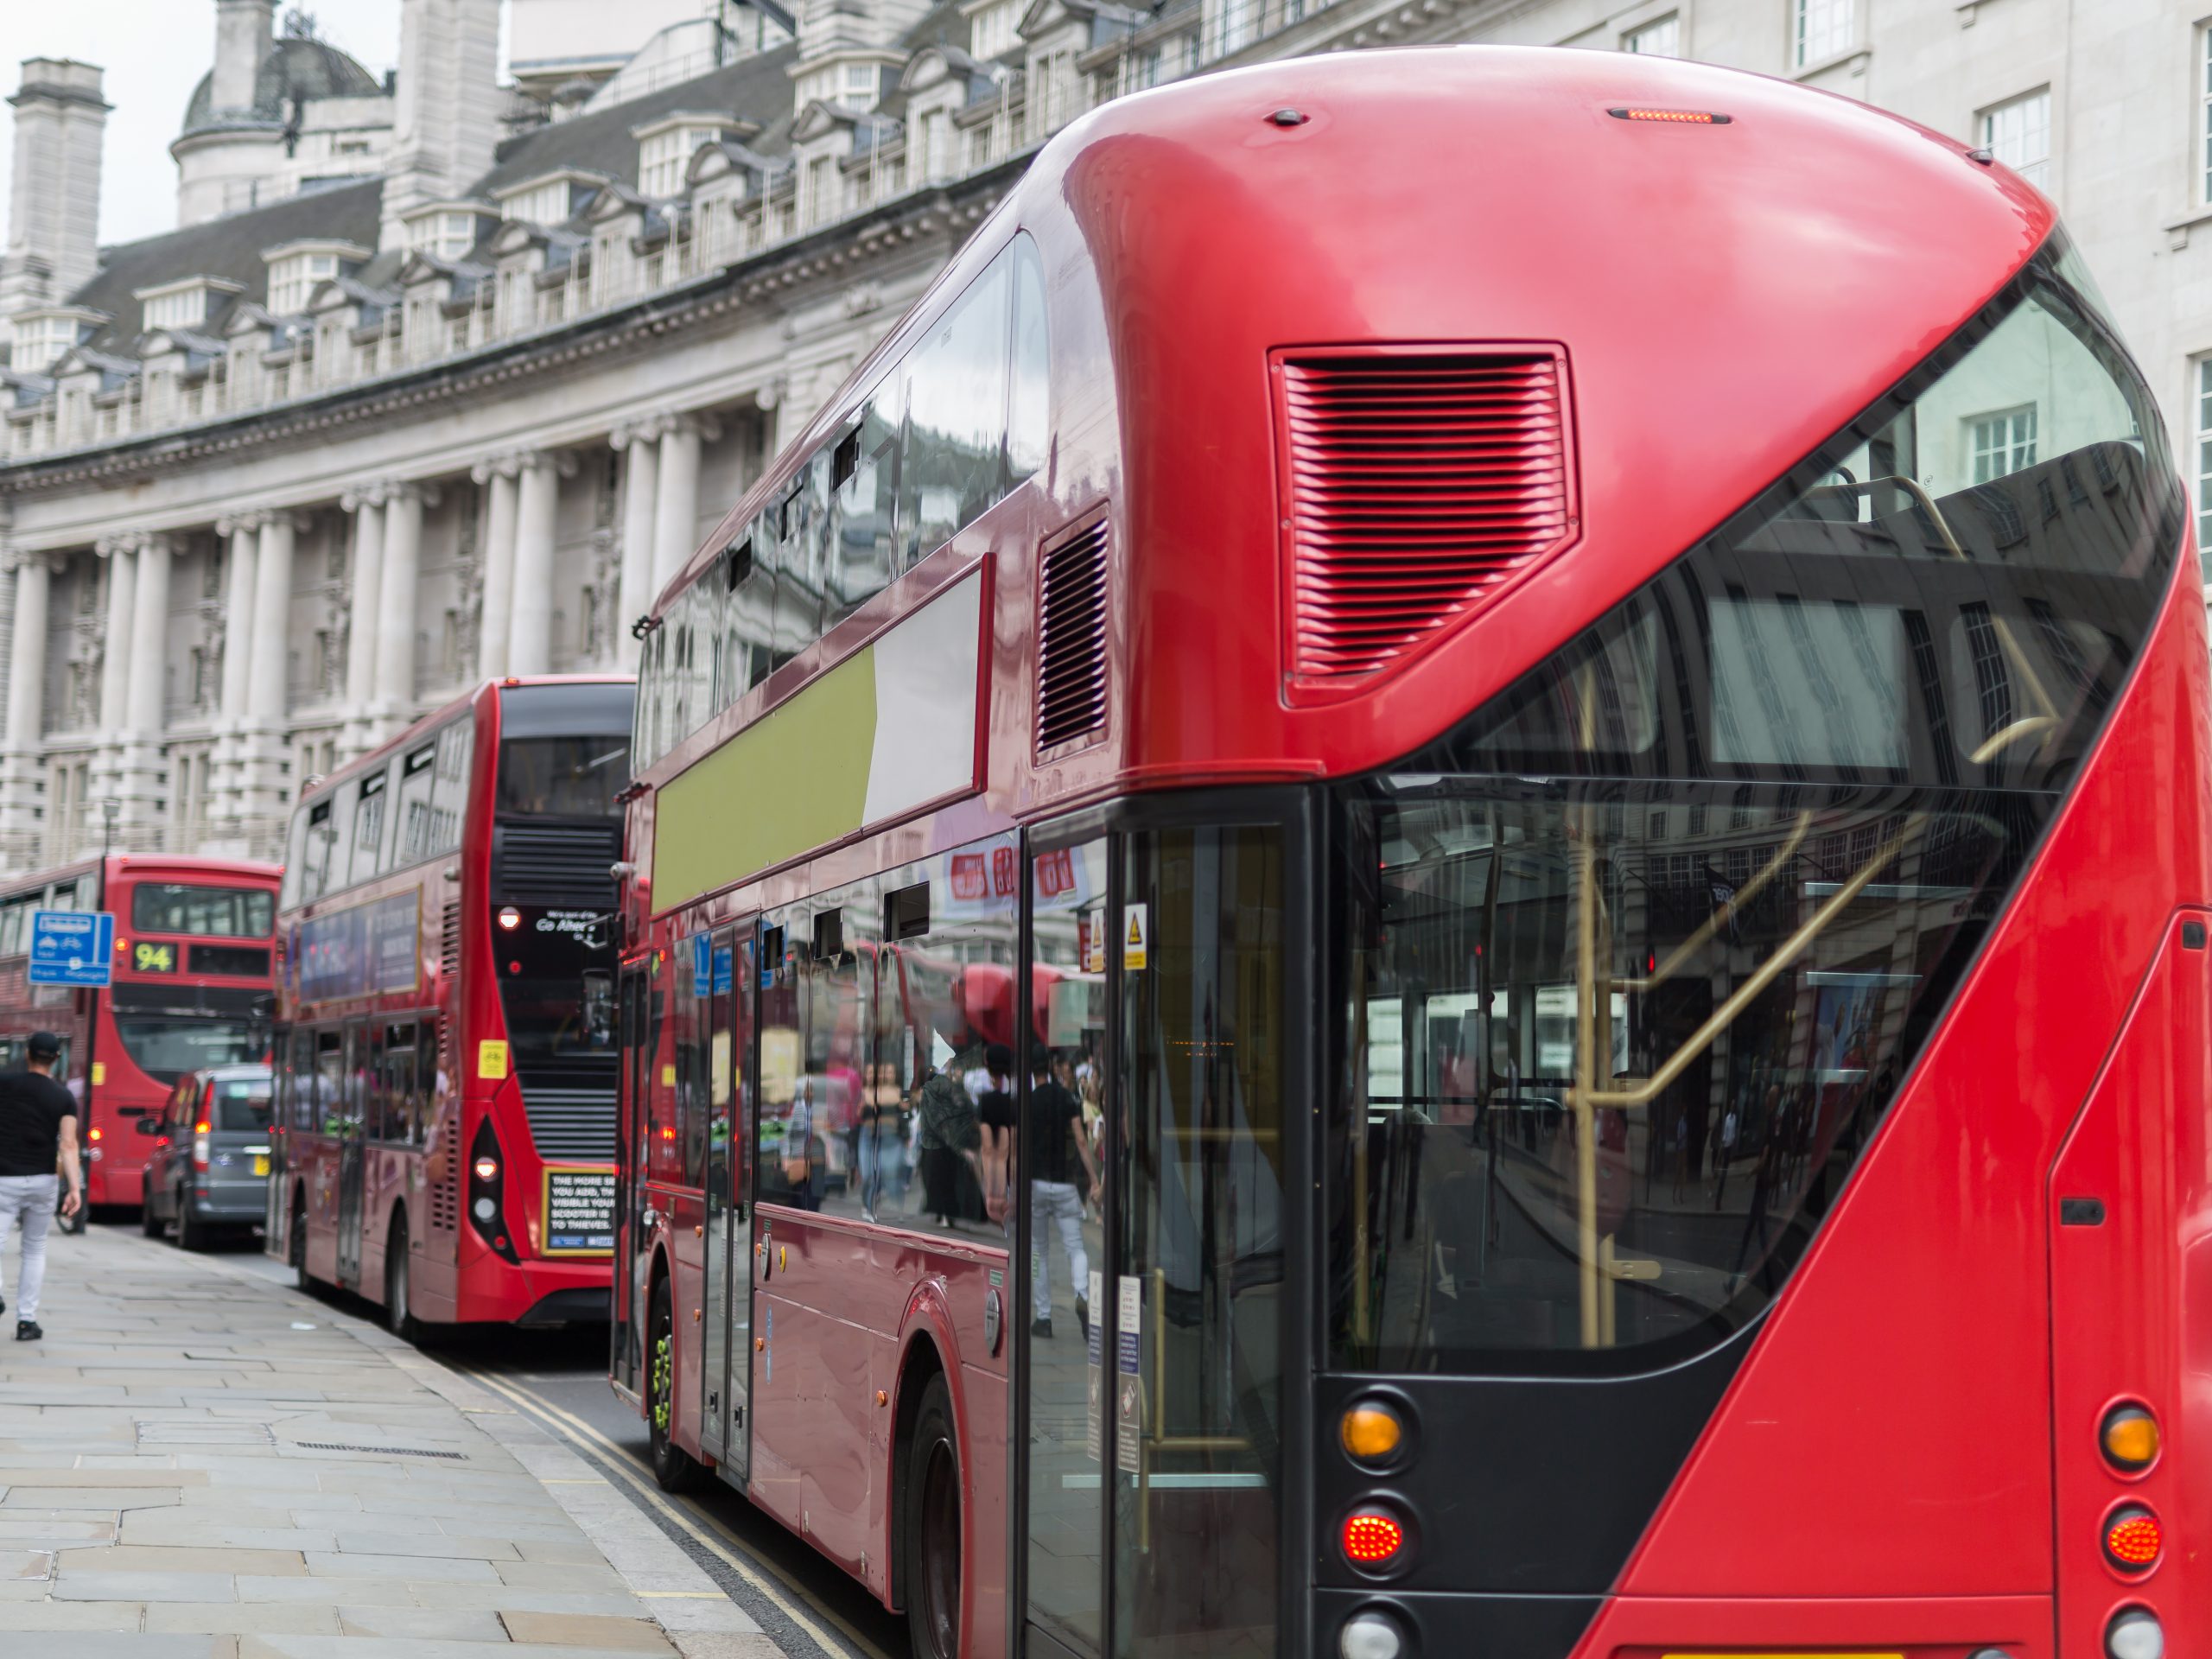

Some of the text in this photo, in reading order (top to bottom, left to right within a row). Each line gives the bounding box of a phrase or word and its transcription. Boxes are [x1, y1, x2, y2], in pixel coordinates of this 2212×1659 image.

[536, 918, 555, 931] Go
[136, 943, 172, 972] 94
[552, 1176, 572, 1185] THE
[573, 1176, 602, 1186] MORE
[552, 1186, 574, 1197] YOU
[551, 1198, 590, 1208] VISIBLE
[551, 1209, 610, 1218] SCOOTER IS
[551, 1219, 567, 1230] TO
